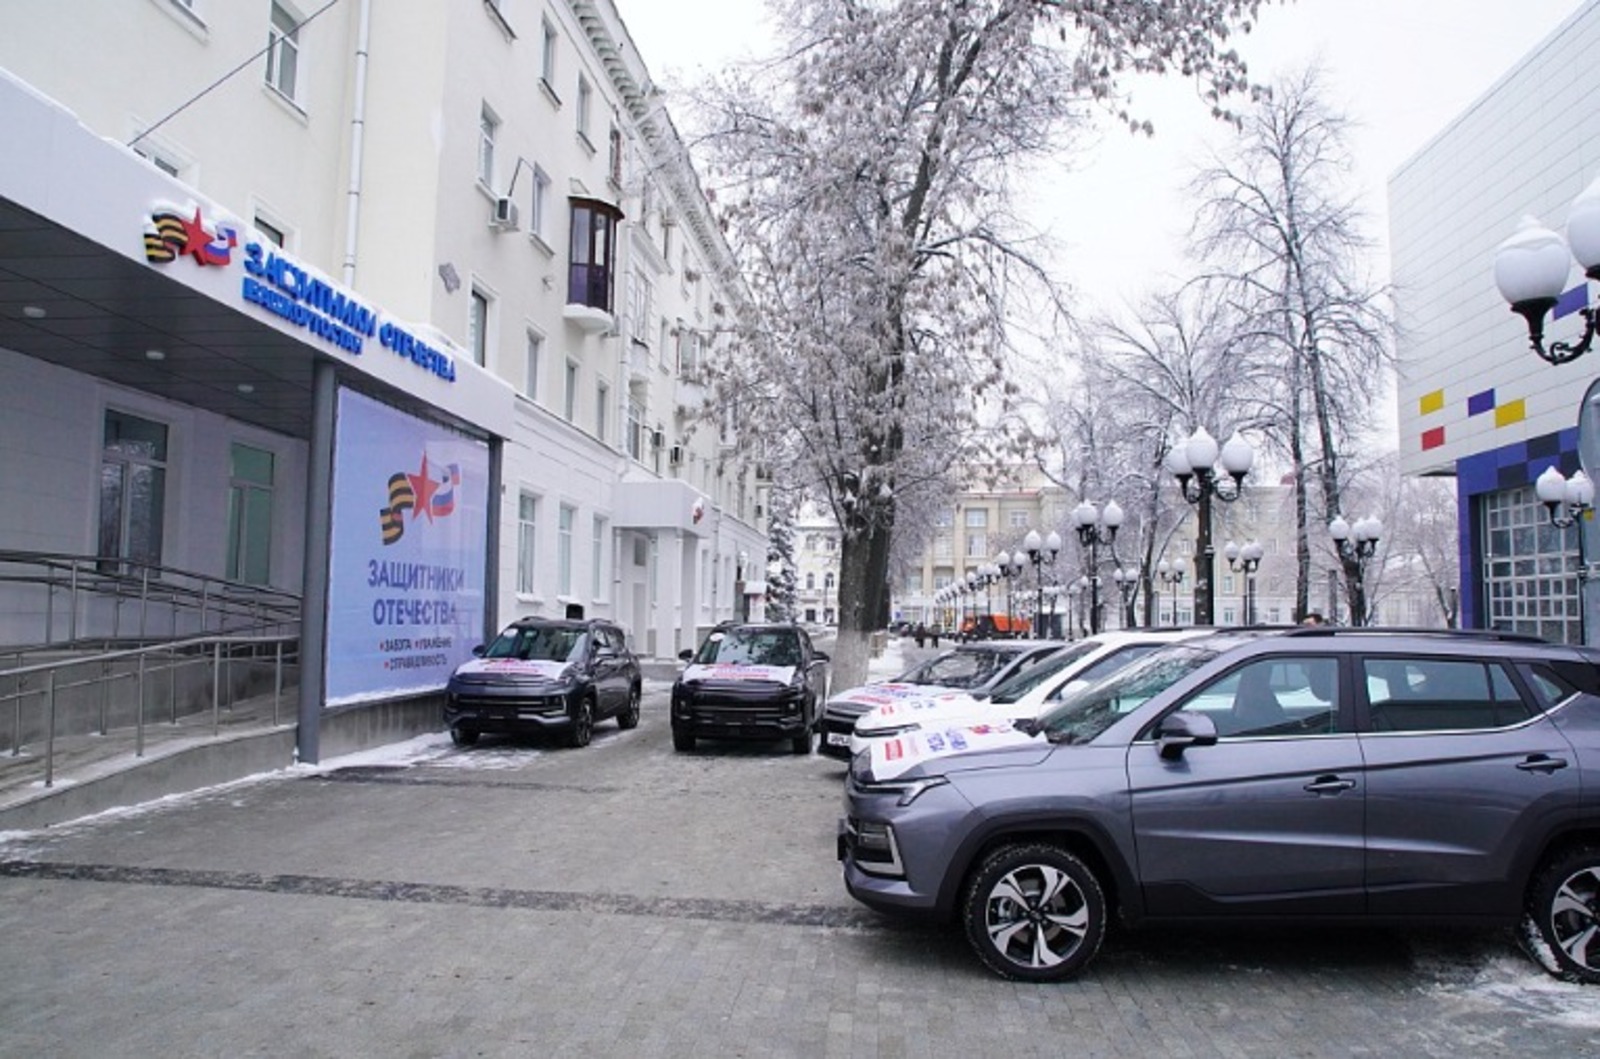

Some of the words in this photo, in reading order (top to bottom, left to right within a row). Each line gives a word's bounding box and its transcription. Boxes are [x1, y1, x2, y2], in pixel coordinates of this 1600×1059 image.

[379, 321, 456, 382] ОТЕЧЕСТВА
[368, 559, 465, 592] ЗАЩИТНИКИ
[373, 599, 457, 625] ОТЕЧЕСТВА
